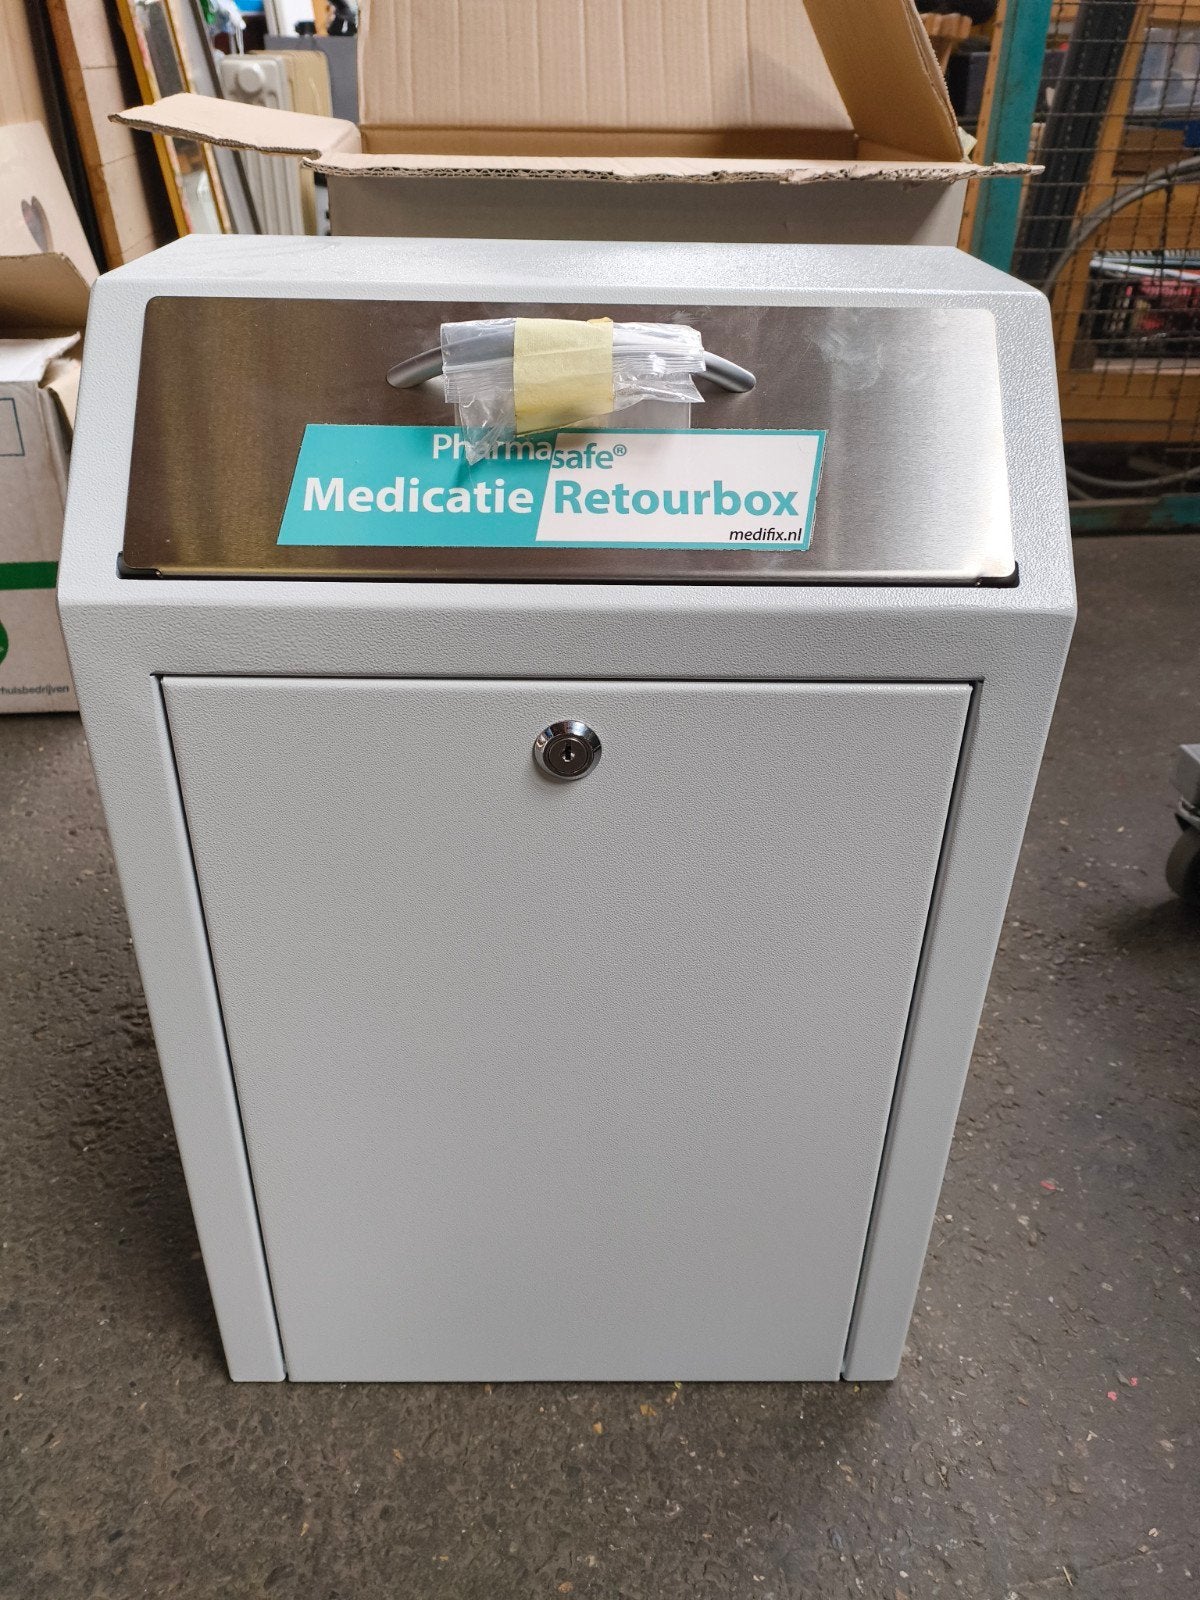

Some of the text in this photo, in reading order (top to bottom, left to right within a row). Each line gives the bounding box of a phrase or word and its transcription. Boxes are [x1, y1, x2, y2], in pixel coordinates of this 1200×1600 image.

[303, 477, 799, 516] Medicatie Retourbox
[729, 527, 802, 541] medifix.nl
[0, 685, 69, 696] huisbedrijven
